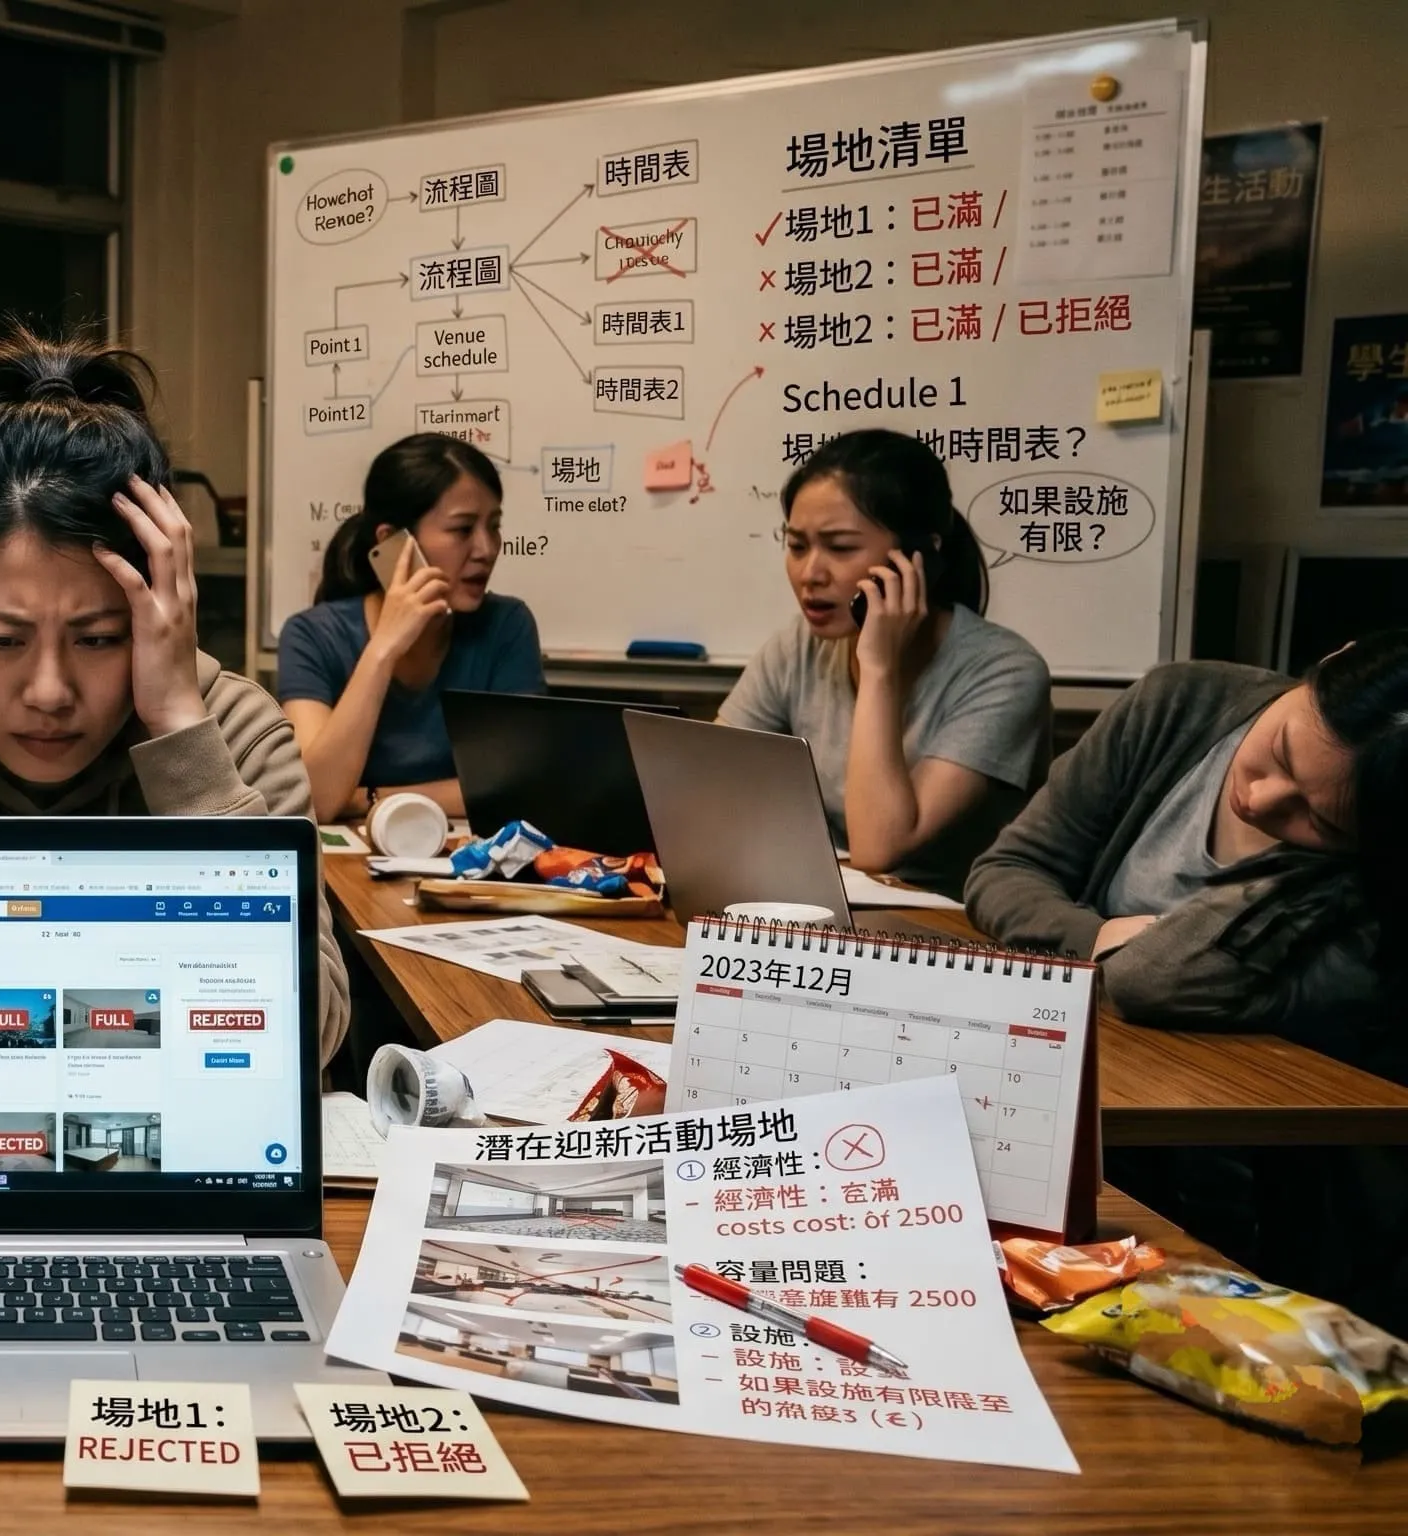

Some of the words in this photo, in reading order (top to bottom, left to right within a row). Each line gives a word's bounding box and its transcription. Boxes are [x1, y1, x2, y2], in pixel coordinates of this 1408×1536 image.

[786, 116, 969, 178] 場地清單
[604, 148, 691, 188] 時間表
[424, 170, 500, 206] 流程圖
[418, 255, 502, 292] 流程圖
[434, 328, 487, 347] Venue
[601, 310, 686, 336] 時間表1
[423, 347, 498, 370] schedule
[595, 378, 680, 402] 時間表2
[783, 376, 938, 413] Schedule
[950, 376, 967, 405] 1
[551, 457, 601, 484] 場地
[544, 496, 585, 513] Time
[999, 485, 1129, 516] 如果設施
[1019, 520, 1106, 553] 有限？
[700, 954, 852, 997] 2023年12月
[95, 1014, 130, 1026] FULL
[192, 1014, 262, 1027] REJECTED
[1032, 1007, 1067, 1022] 2021
[901, 1023, 906, 1033] 1
[954, 1031, 960, 1040] 2
[1011, 1039, 1017, 1048] 3
[693, 1027, 700, 1035] 4
[742, 1034, 748, 1042] 5
[791, 1041, 798, 1050] 6
[843, 1048, 849, 1057] 7
[896, 1056, 903, 1065] 8
[950, 1064, 957, 1074] 9
[1007, 1073, 1021, 1084] 10
[691, 1058, 701, 1067] 11
[739, 1066, 750, 1075] 12
[788, 1073, 800, 1083] 13
[839, 1081, 851, 1091] 14
[1002, 1107, 1016, 1118] 17
[475, 1109, 798, 1162] 潛在迎新活動場地
[687, 1090, 698, 1099] 18
[997, 1142, 1011, 1152] 24
[716, 1217, 785, 1236] costs
[792, 1215, 856, 1233] cost:
[899, 1204, 963, 1228] 2500
[909, 1289, 977, 1307] 2500
[91, 1397, 225, 1428] 場地1:
[330, 1403, 468, 1433] 場地2:
[78, 1437, 240, 1464] REJECTED
[344, 1441, 487, 1473] 已拒絕
